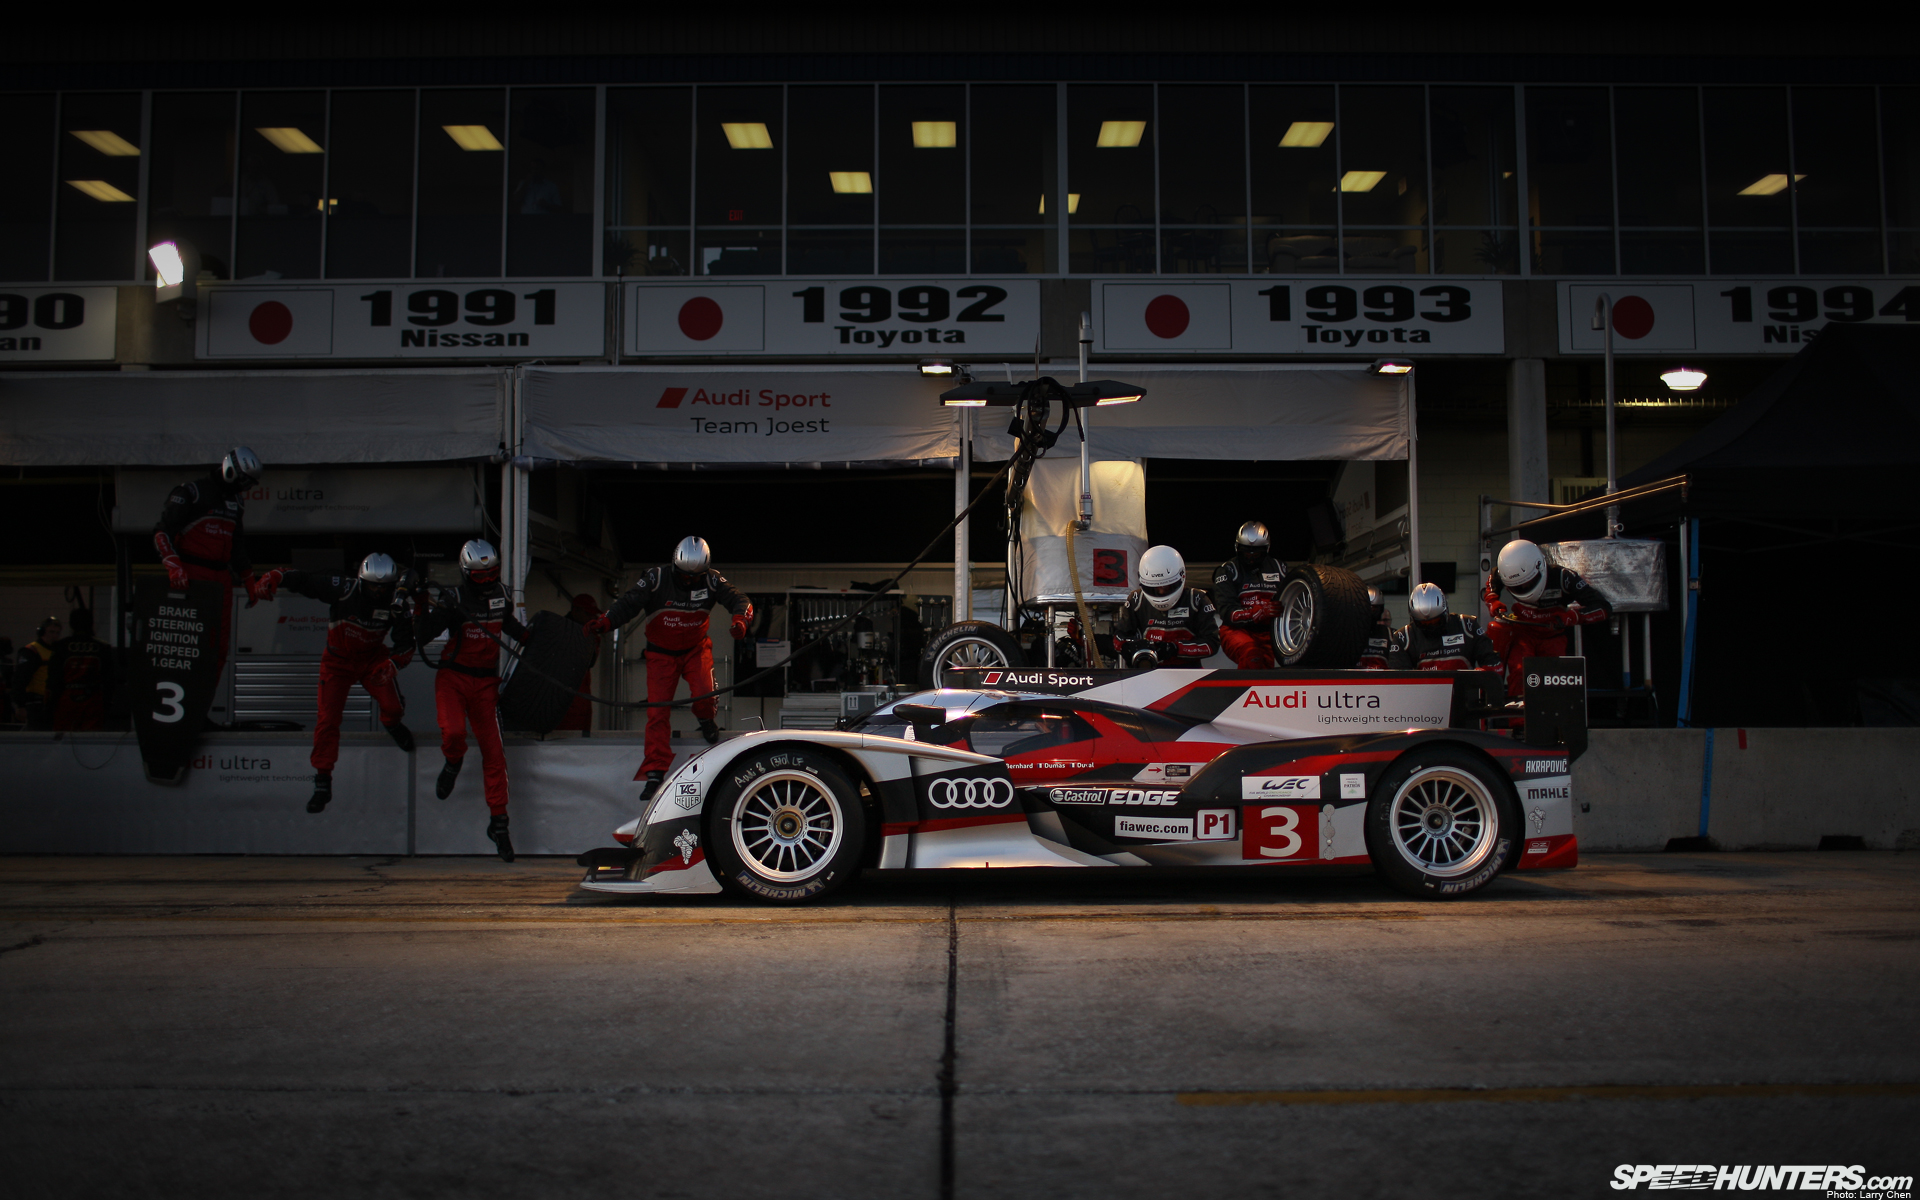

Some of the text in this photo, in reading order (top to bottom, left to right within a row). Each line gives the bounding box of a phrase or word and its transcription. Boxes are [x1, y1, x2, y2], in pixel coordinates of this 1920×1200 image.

[729, 209, 744, 221] EXIT
[360, 289, 556, 327] 1991
[792, 285, 1008, 323] 1992
[1258, 285, 1471, 323] 1993
[1720, 285, 1920, 322] 1994
[401, 329, 529, 347] Nissan
[834, 325, 966, 348] Toyota
[1301, 325, 1431, 348] Toyota
[691, 387, 831, 411] Audi Sport
[690, 417, 830, 436] Team Joest
[240, 487, 323, 501] udi ultra
[325, 504, 370, 512] technology
[1095, 550, 1126, 585] 3
[158, 605, 198, 619] BRAKE
[148, 618, 204, 633] STEERING
[310, 616, 330, 624] Spor
[150, 631, 198, 645] IGNITION
[931, 625, 977, 651] MICHELIN
[145, 643, 200, 658] PITSPEED
[151, 657, 192, 671] 1.GEAR
[1005, 671, 1094, 687] Audi Sport
[1543, 675, 1583, 686] BOSCH
[152, 681, 186, 724] 3
[1242, 690, 1381, 709] Audi ultra
[1317, 714, 1444, 725] lightweight technology
[220, 755, 271, 770] ultra
[1525, 758, 1567, 773] AKRAPOVIČ
[219, 774, 317, 783] lightweight technolog
[1262, 778, 1310, 790] WEC
[680, 784, 697, 795] TAG
[1527, 787, 1568, 800] MAHLE
[676, 796, 700, 809] HEUER
[1064, 790, 1181, 806] Castrol EDGE
[1119, 820, 1189, 835] fiawec.com
[1203, 813, 1230, 835] P1
[1259, 806, 1302, 858] 3
[1442, 857, 1503, 893] MICHELIN
[739, 875, 806, 899] MICHELIN
